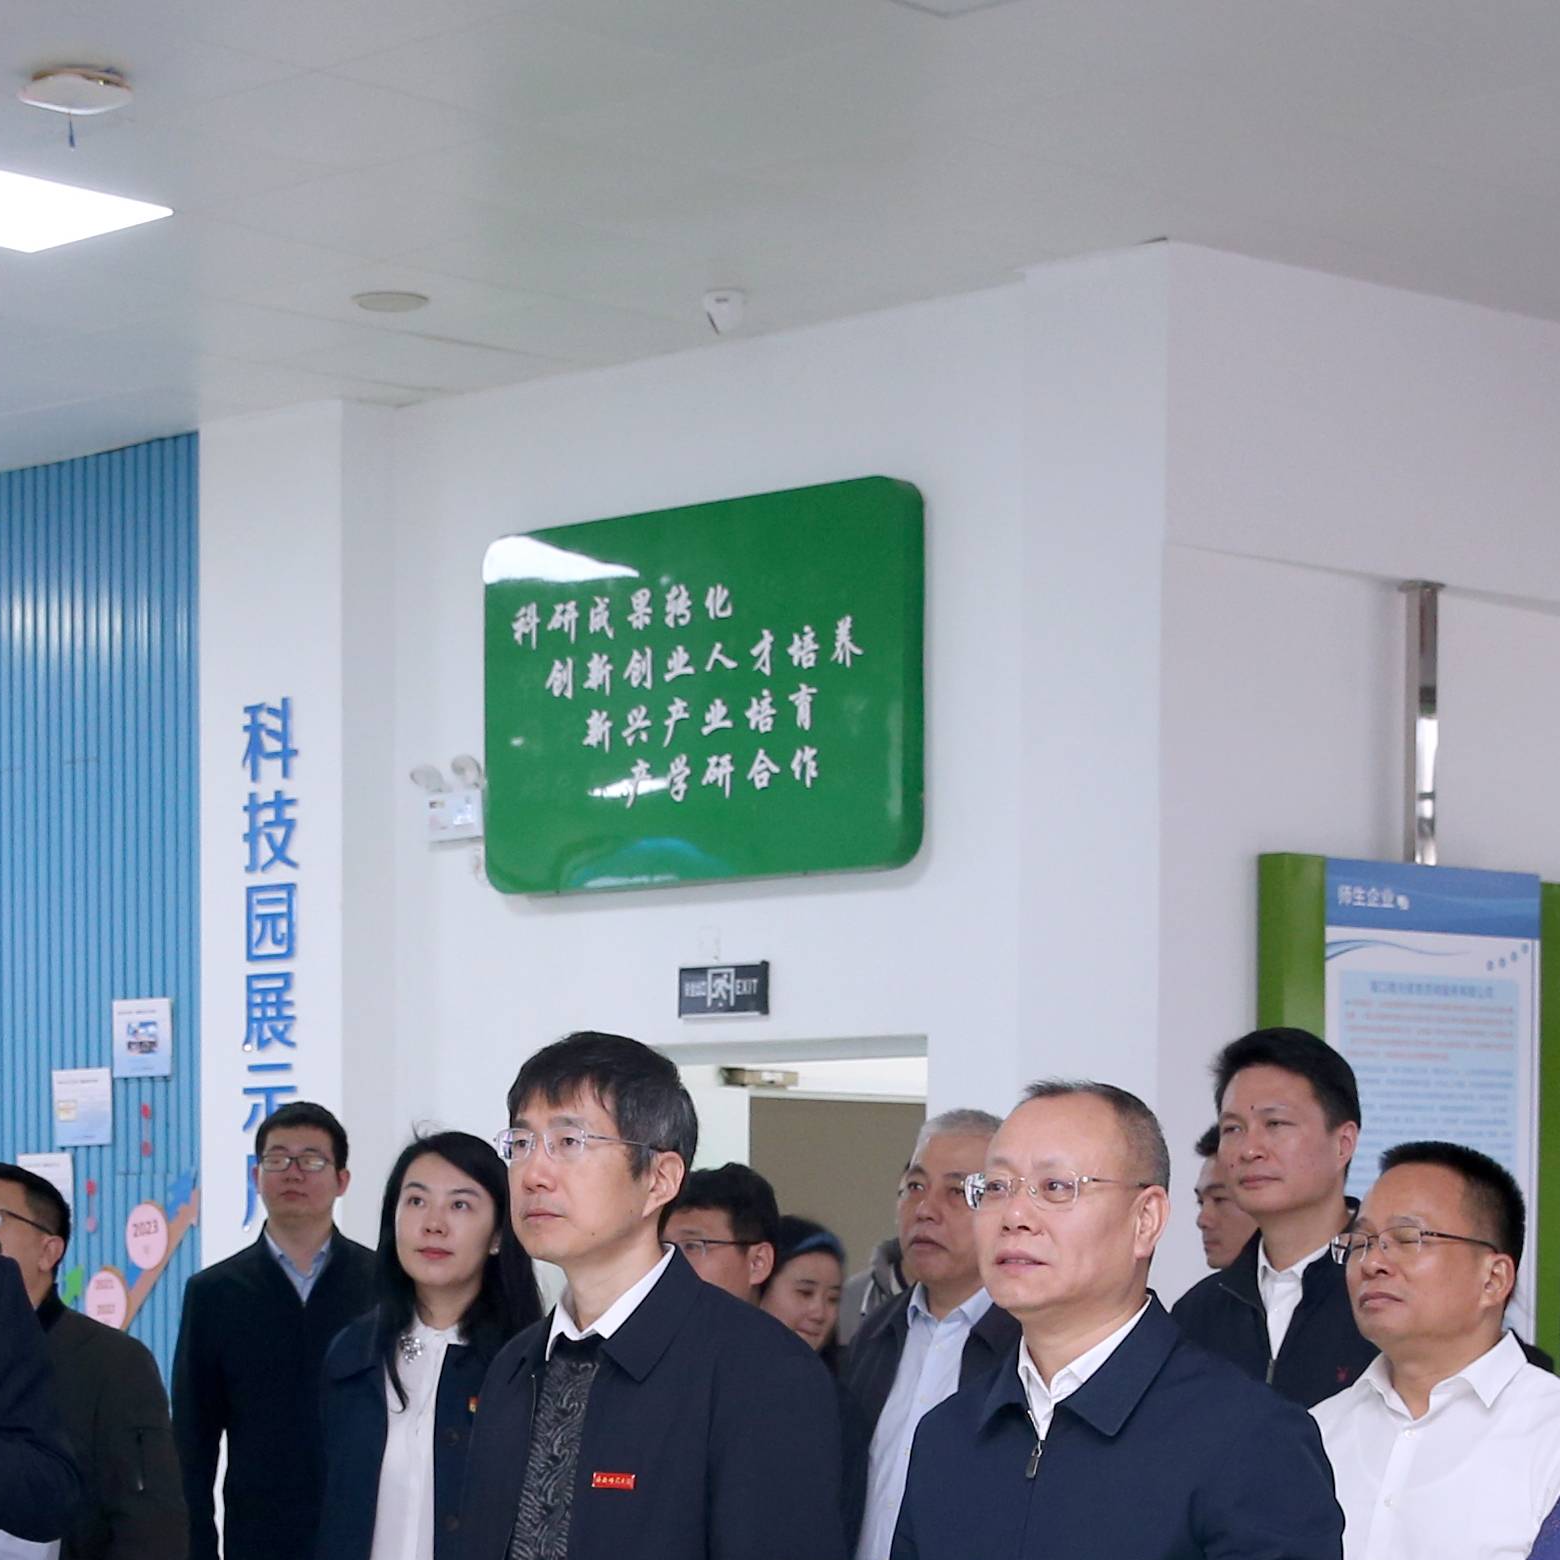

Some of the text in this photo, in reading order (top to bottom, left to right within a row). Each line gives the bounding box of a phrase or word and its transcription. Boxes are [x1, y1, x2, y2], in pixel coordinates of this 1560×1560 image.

[511, 583, 734, 650] 科研成果转化
[544, 614, 864, 700] 创新创业人才培养
[582, 683, 818, 753] 新兴产业培育
[625, 745, 820, 809] 产学研合作
[242, 696, 300, 1226] 科技园展示
[132, 1218, 160, 1238] 2023
